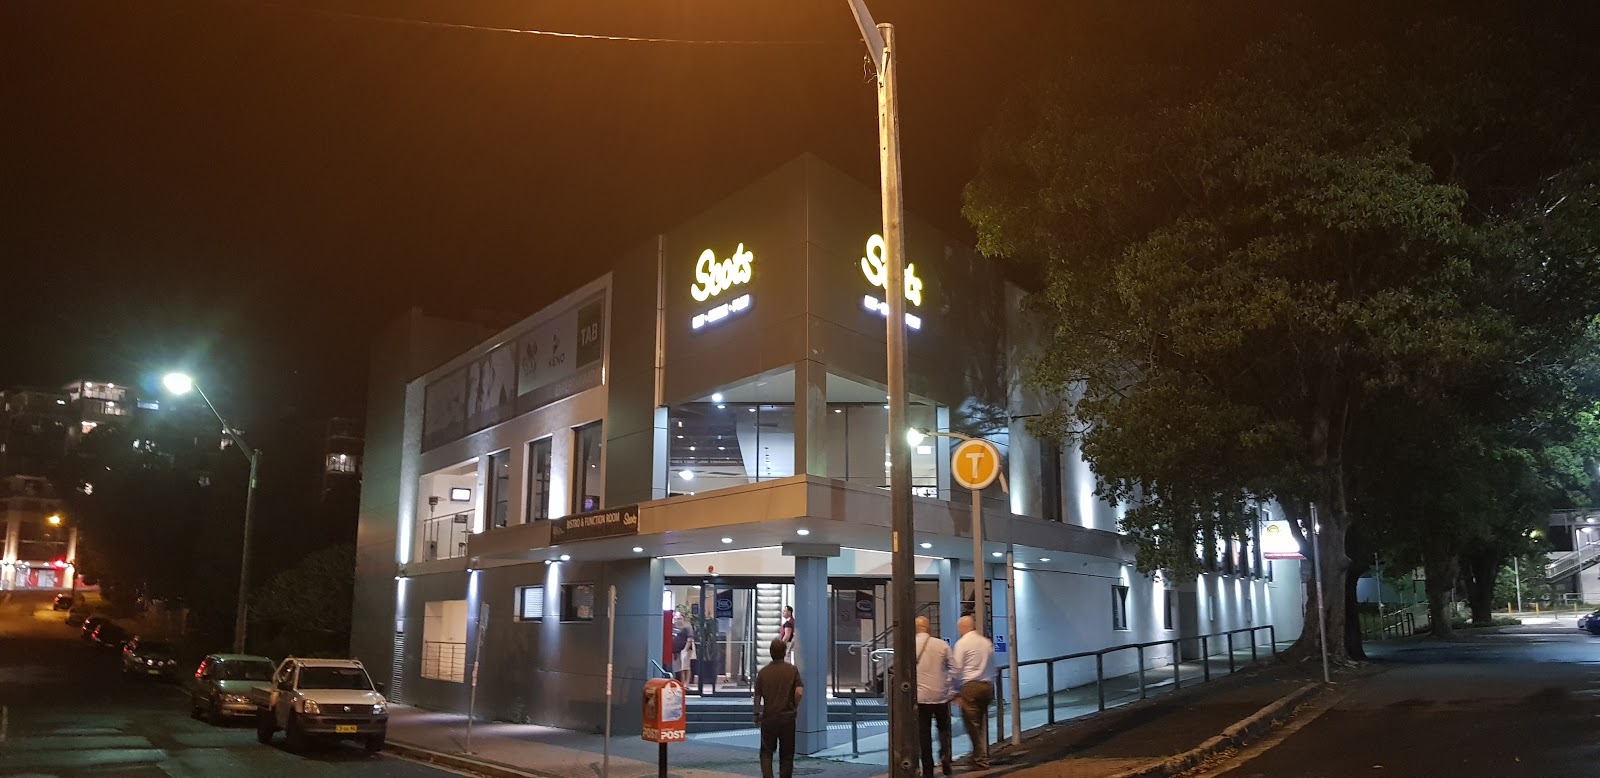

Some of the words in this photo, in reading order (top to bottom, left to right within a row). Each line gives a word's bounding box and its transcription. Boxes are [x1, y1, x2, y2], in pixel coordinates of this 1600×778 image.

[861, 234, 923, 306] Sts
[581, 323, 598, 346] TAB
[965, 452, 985, 479] T
[566, 518, 581, 530] BISTRO
[584, 513, 606, 526] FUNCTION
[605, 511, 621, 523] ROOM
[643, 728, 659, 740] POST
[661, 729, 686, 740] POST
